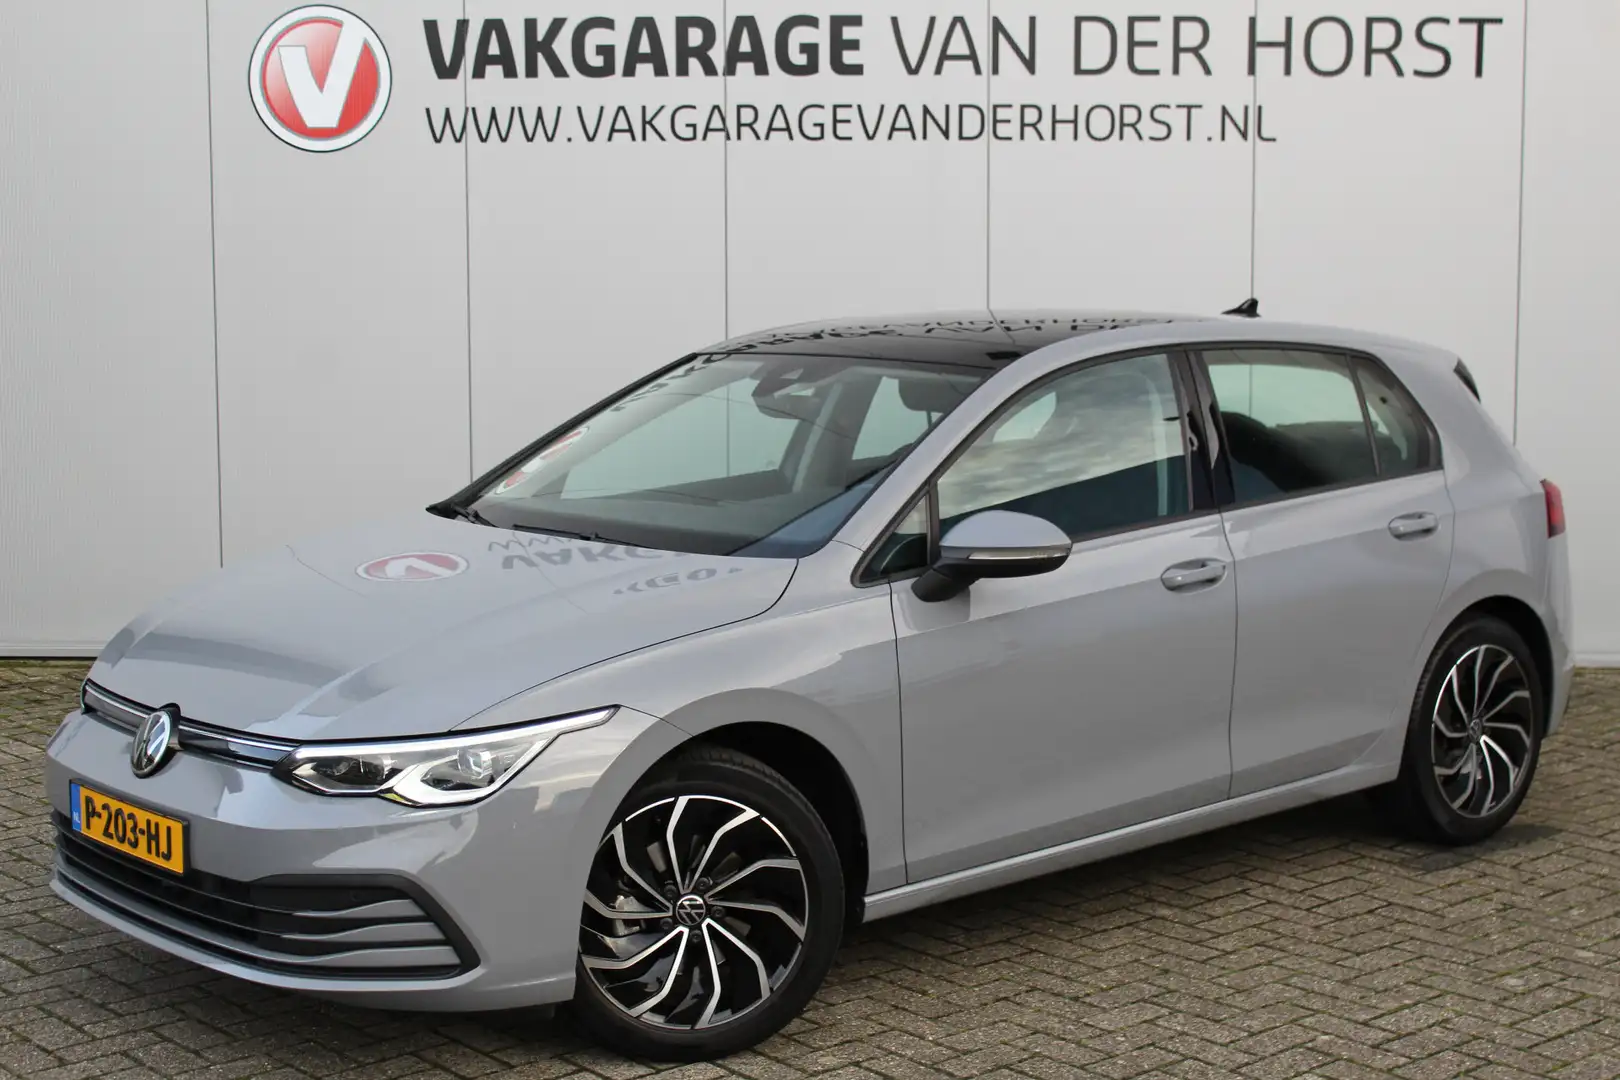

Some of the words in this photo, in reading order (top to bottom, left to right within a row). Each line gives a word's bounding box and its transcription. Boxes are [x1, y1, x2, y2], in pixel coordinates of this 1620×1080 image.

[423, 14, 864, 80] VAKGARAGE
[890, 15, 1037, 76] VAN
[1073, 15, 1212, 76] DER
[1247, 16, 1504, 78] HORST
[425, 103, 1277, 144] WWW.VAKGARAGEVANDERHORST.NL
[84, 795, 172, 861] P-203-HJ
